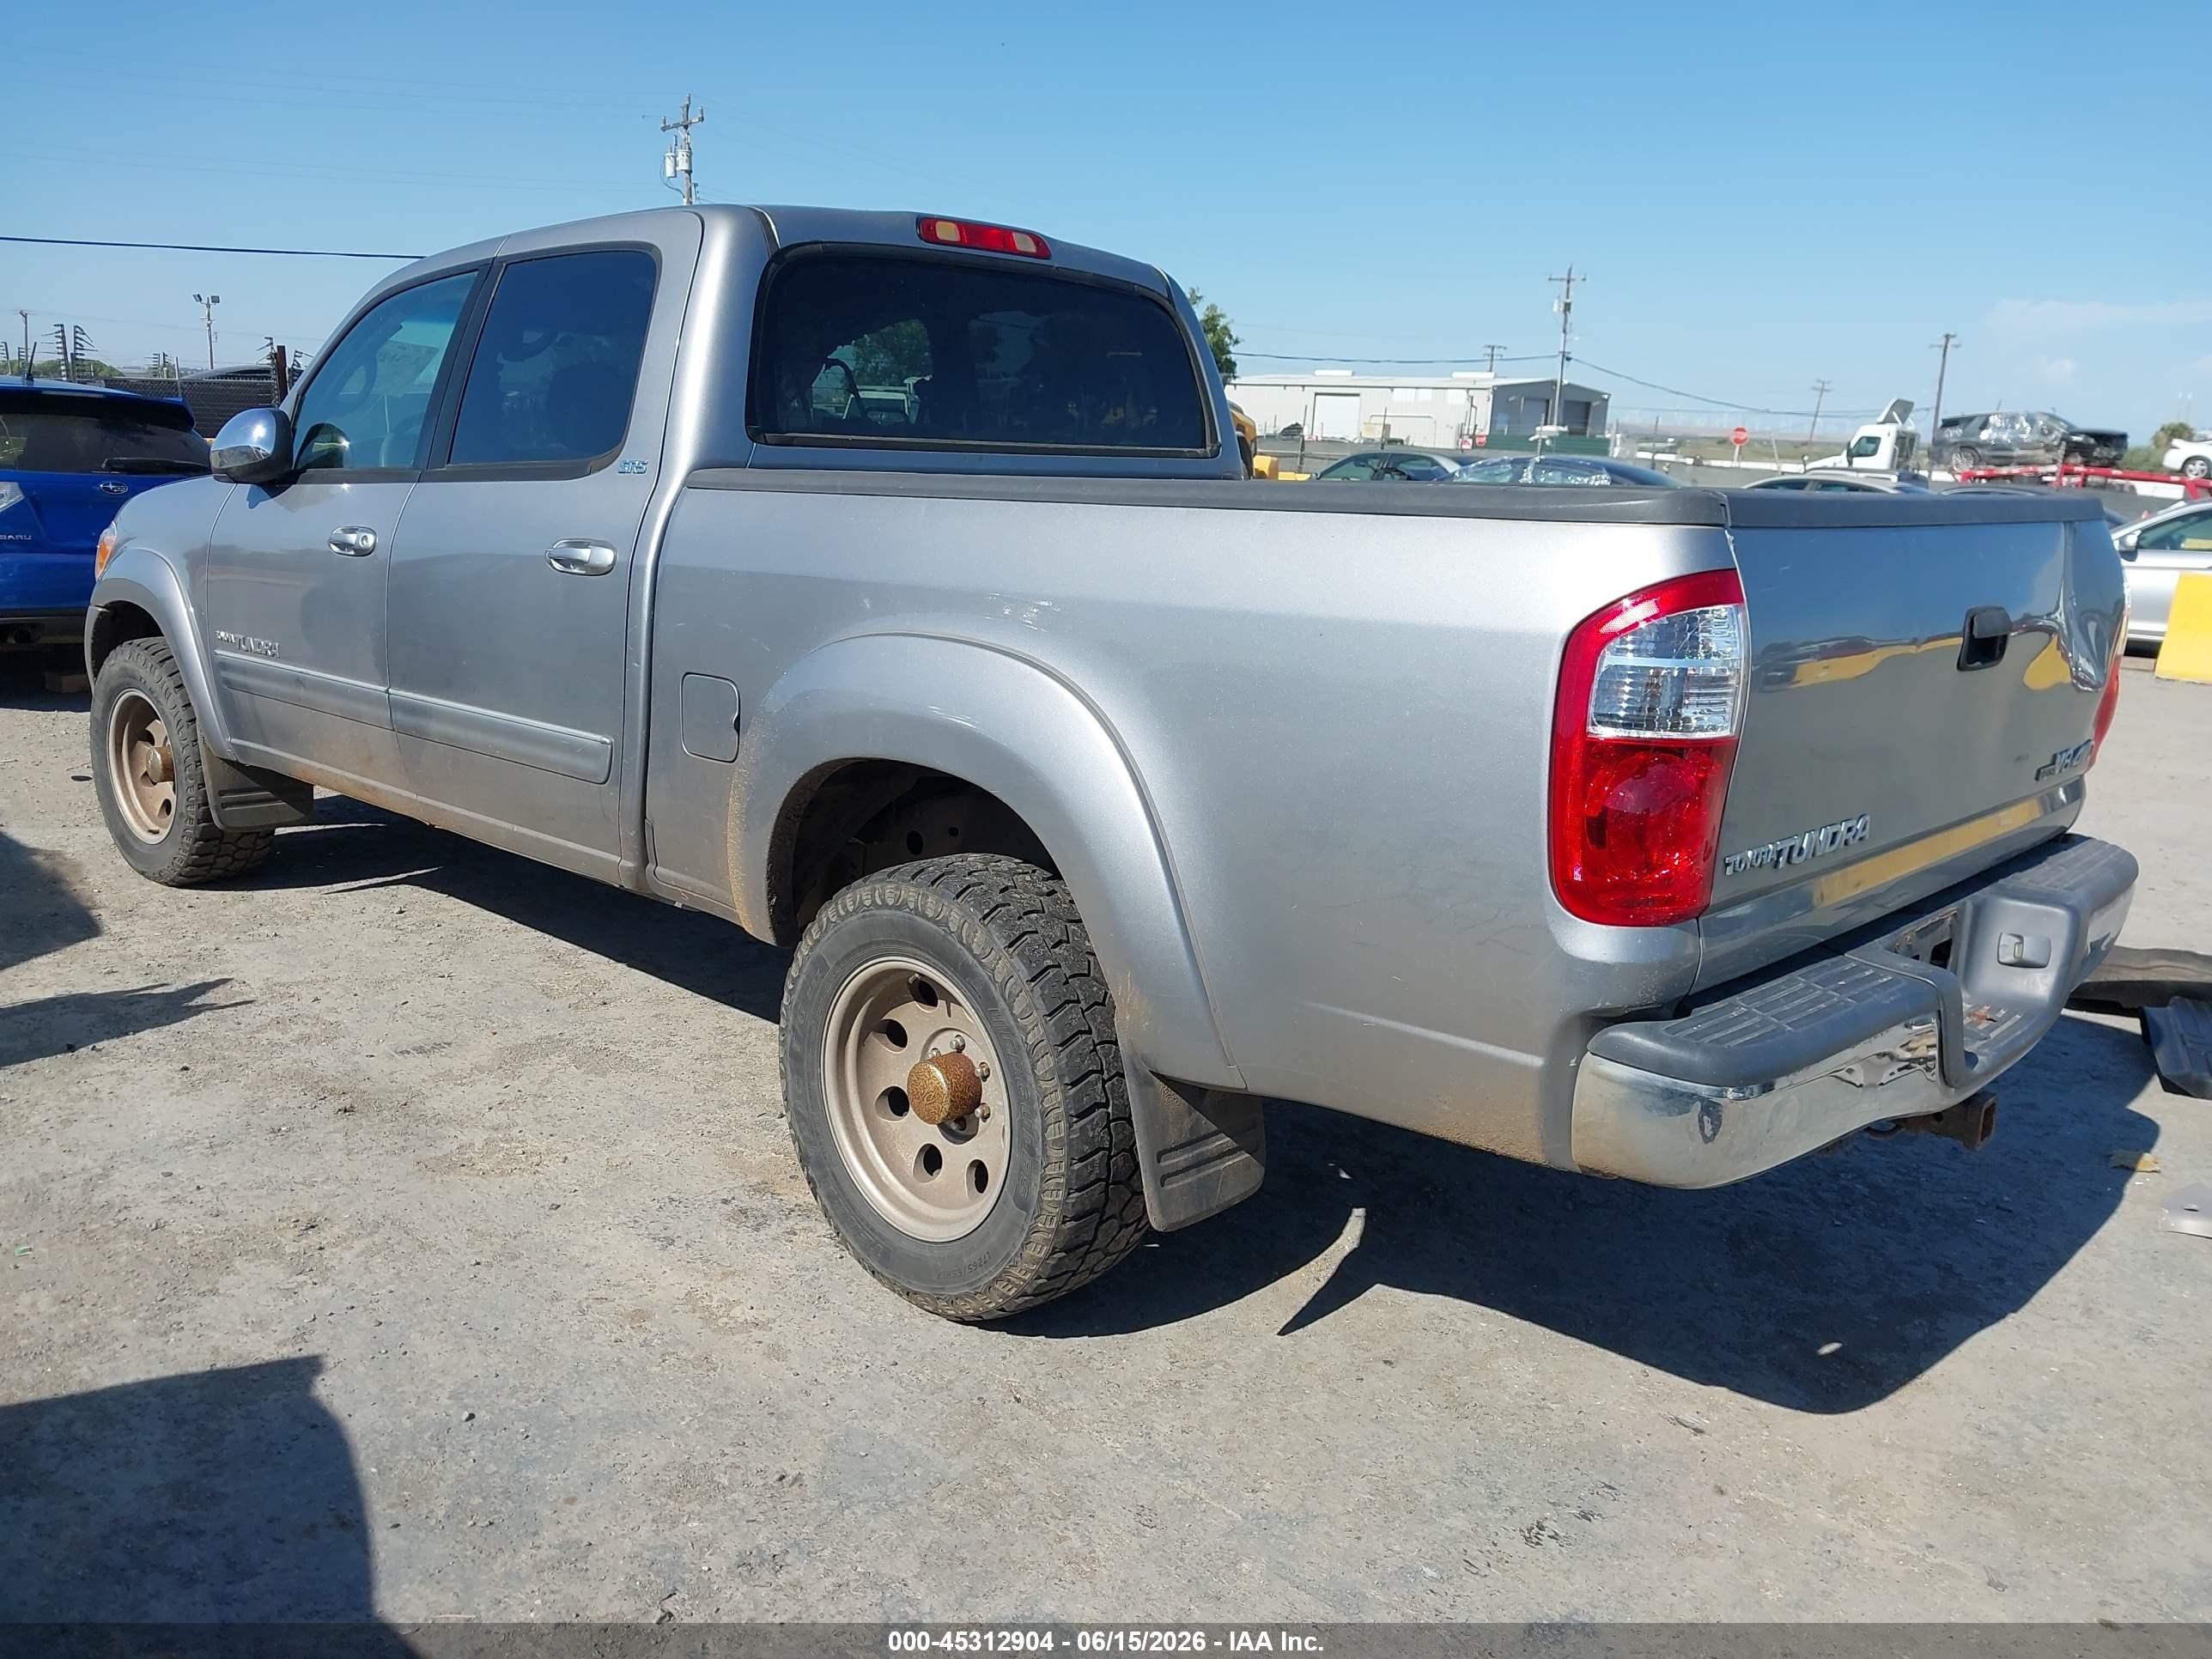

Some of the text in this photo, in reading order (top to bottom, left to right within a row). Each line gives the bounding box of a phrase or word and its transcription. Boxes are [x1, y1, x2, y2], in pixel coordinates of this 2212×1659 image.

[235, 635, 281, 659] TUNDRA
[1724, 813, 1870, 876] TOYOTA TUNDRA
